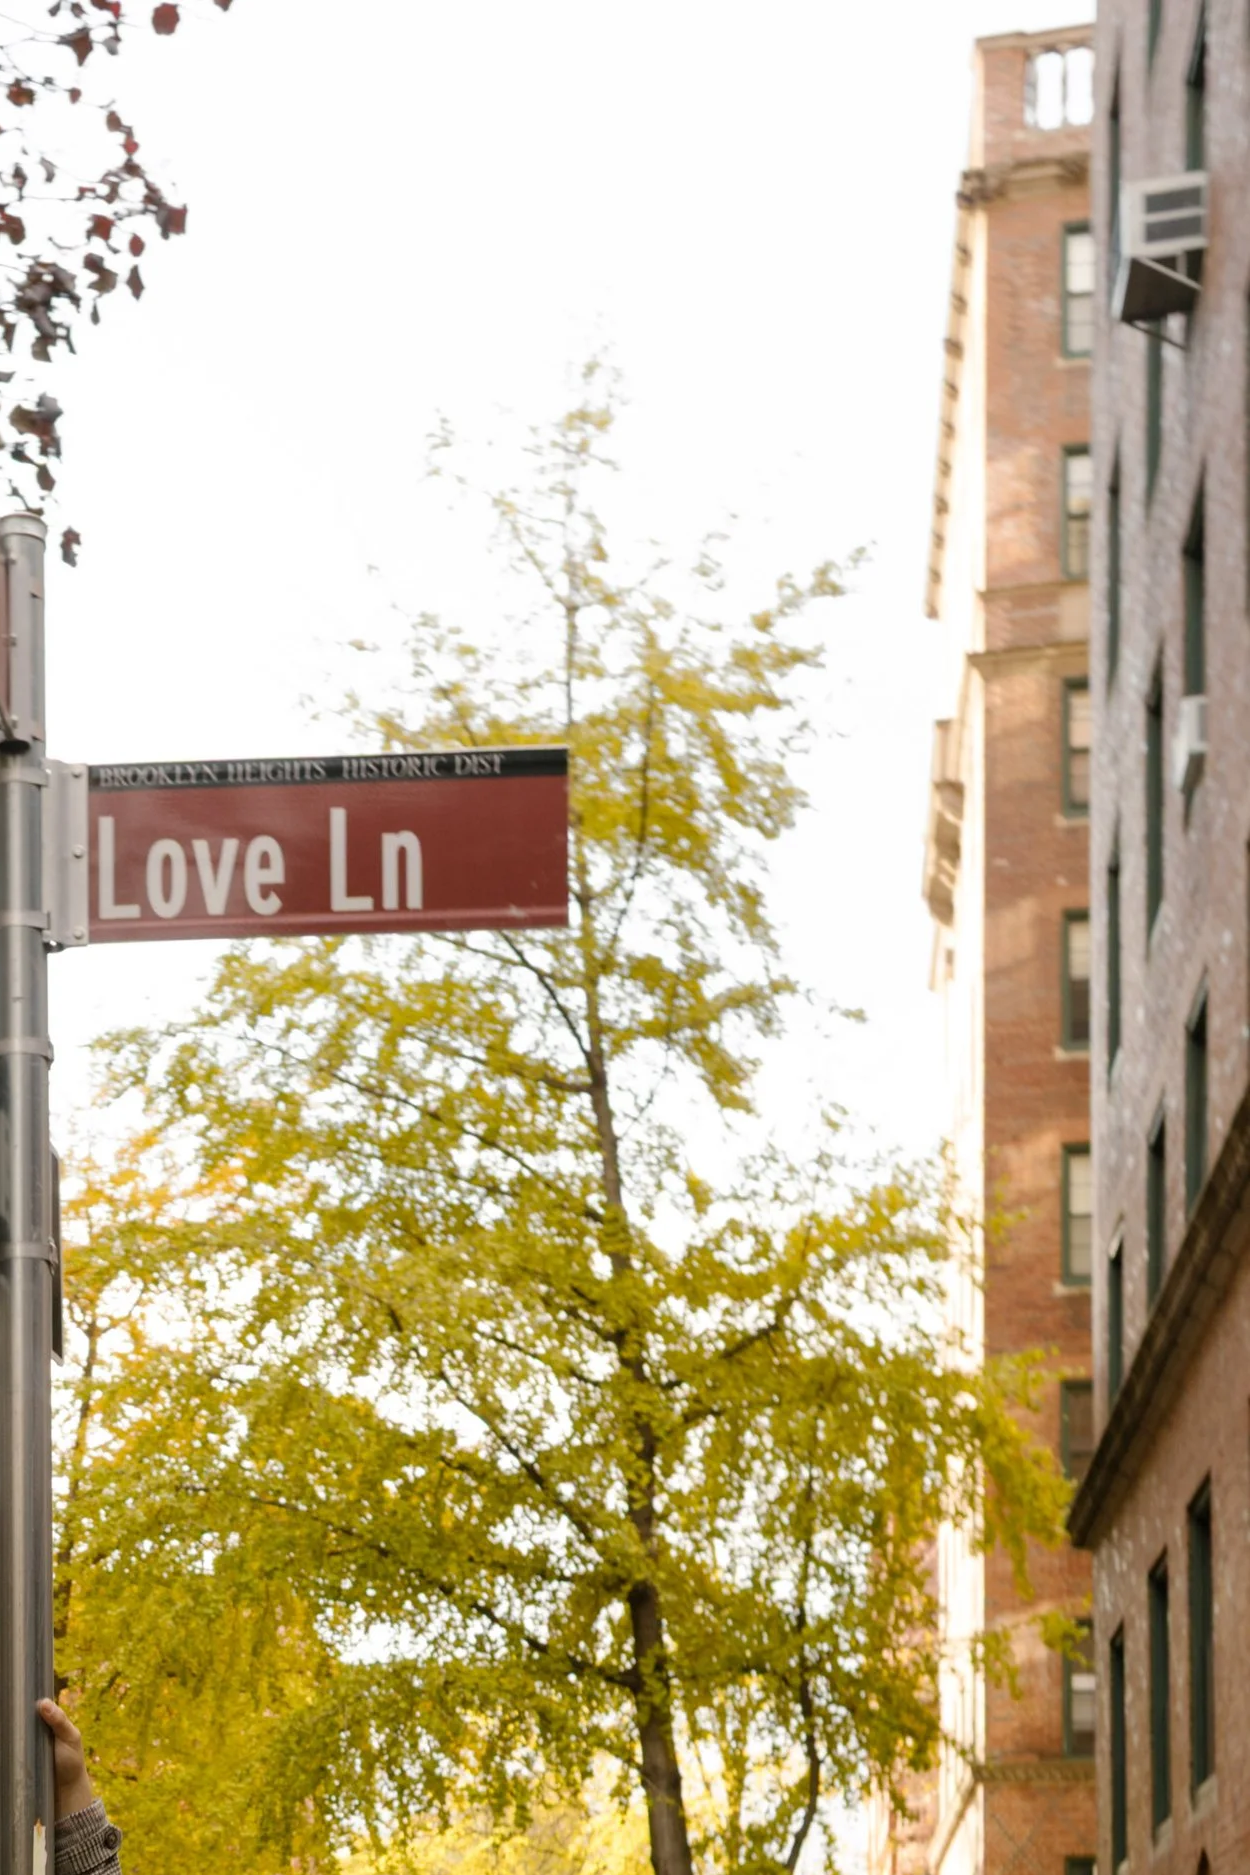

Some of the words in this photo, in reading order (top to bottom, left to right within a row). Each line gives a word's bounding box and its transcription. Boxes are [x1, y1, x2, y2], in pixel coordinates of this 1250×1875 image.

[100, 762, 219, 787] BROOKLYN
[227, 759, 327, 782] HEIGHTS
[342, 756, 448, 780] HISTORIC
[454, 754, 505, 776] DIST
[98, 815, 285, 919] Love
[329, 806, 423, 912] Ln
